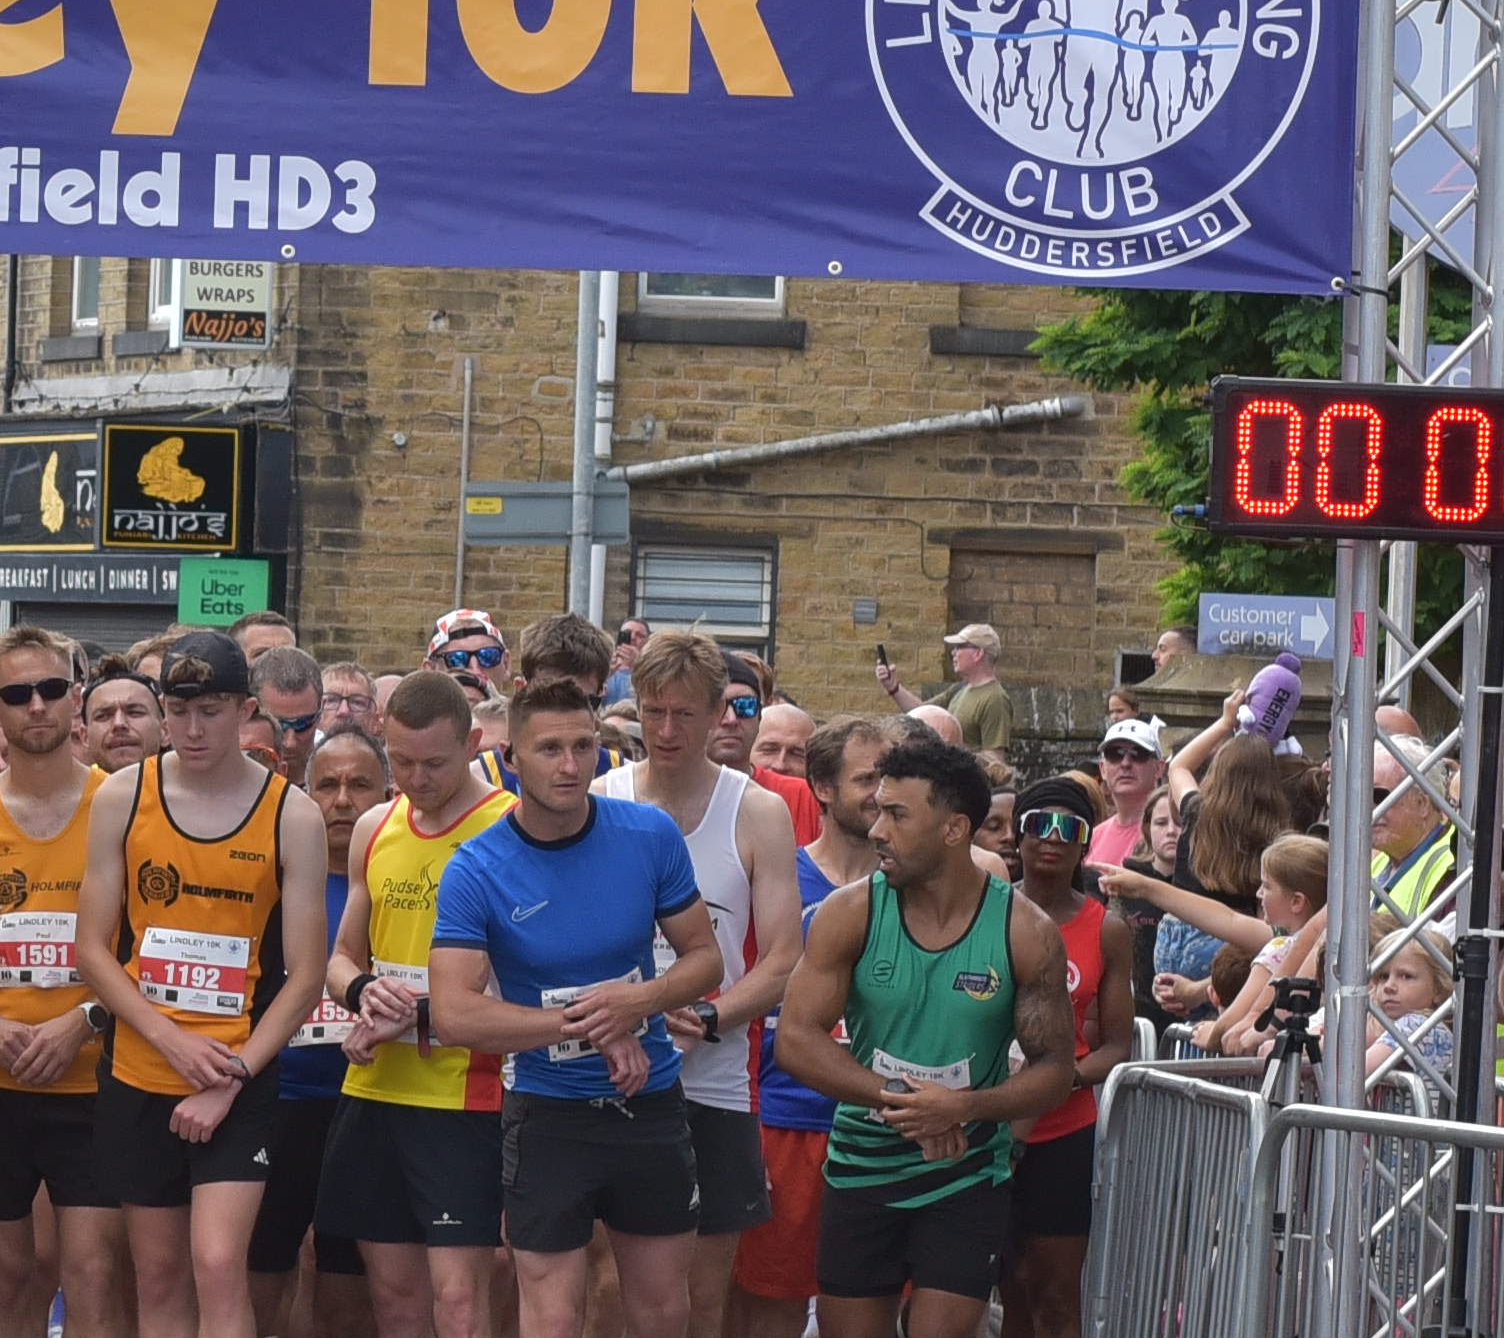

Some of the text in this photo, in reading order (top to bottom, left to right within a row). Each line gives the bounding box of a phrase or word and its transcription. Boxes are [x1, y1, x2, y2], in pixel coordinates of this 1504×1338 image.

[212, 153, 377, 234] HD3
[1004, 160, 1159, 221] CLUB
[945, 200, 1222, 268] HUDDERSFIELD
[189, 261, 264, 278] BURGERS
[196, 286, 255, 303] WRAPS
[184, 311, 265, 342] Najjo's
[1233, 397, 1384, 519] 00
[60, 568, 96, 590] LUNCH
[108, 569, 149, 590] DINNER
[200, 578, 246, 597] Uber
[200, 597, 245, 615] Eats
[1208, 602, 1296, 625] Customer
[1219, 627, 1295, 652] car park
[182, 882, 254, 903] HOLMFIRTH
[383, 893, 424, 911] Pacers
[18, 918, 52, 926] LINDLEY
[169, 936, 205, 949] LINDLEY
[17, 944, 68, 966] 1591
[164, 962, 221, 990] 1192
